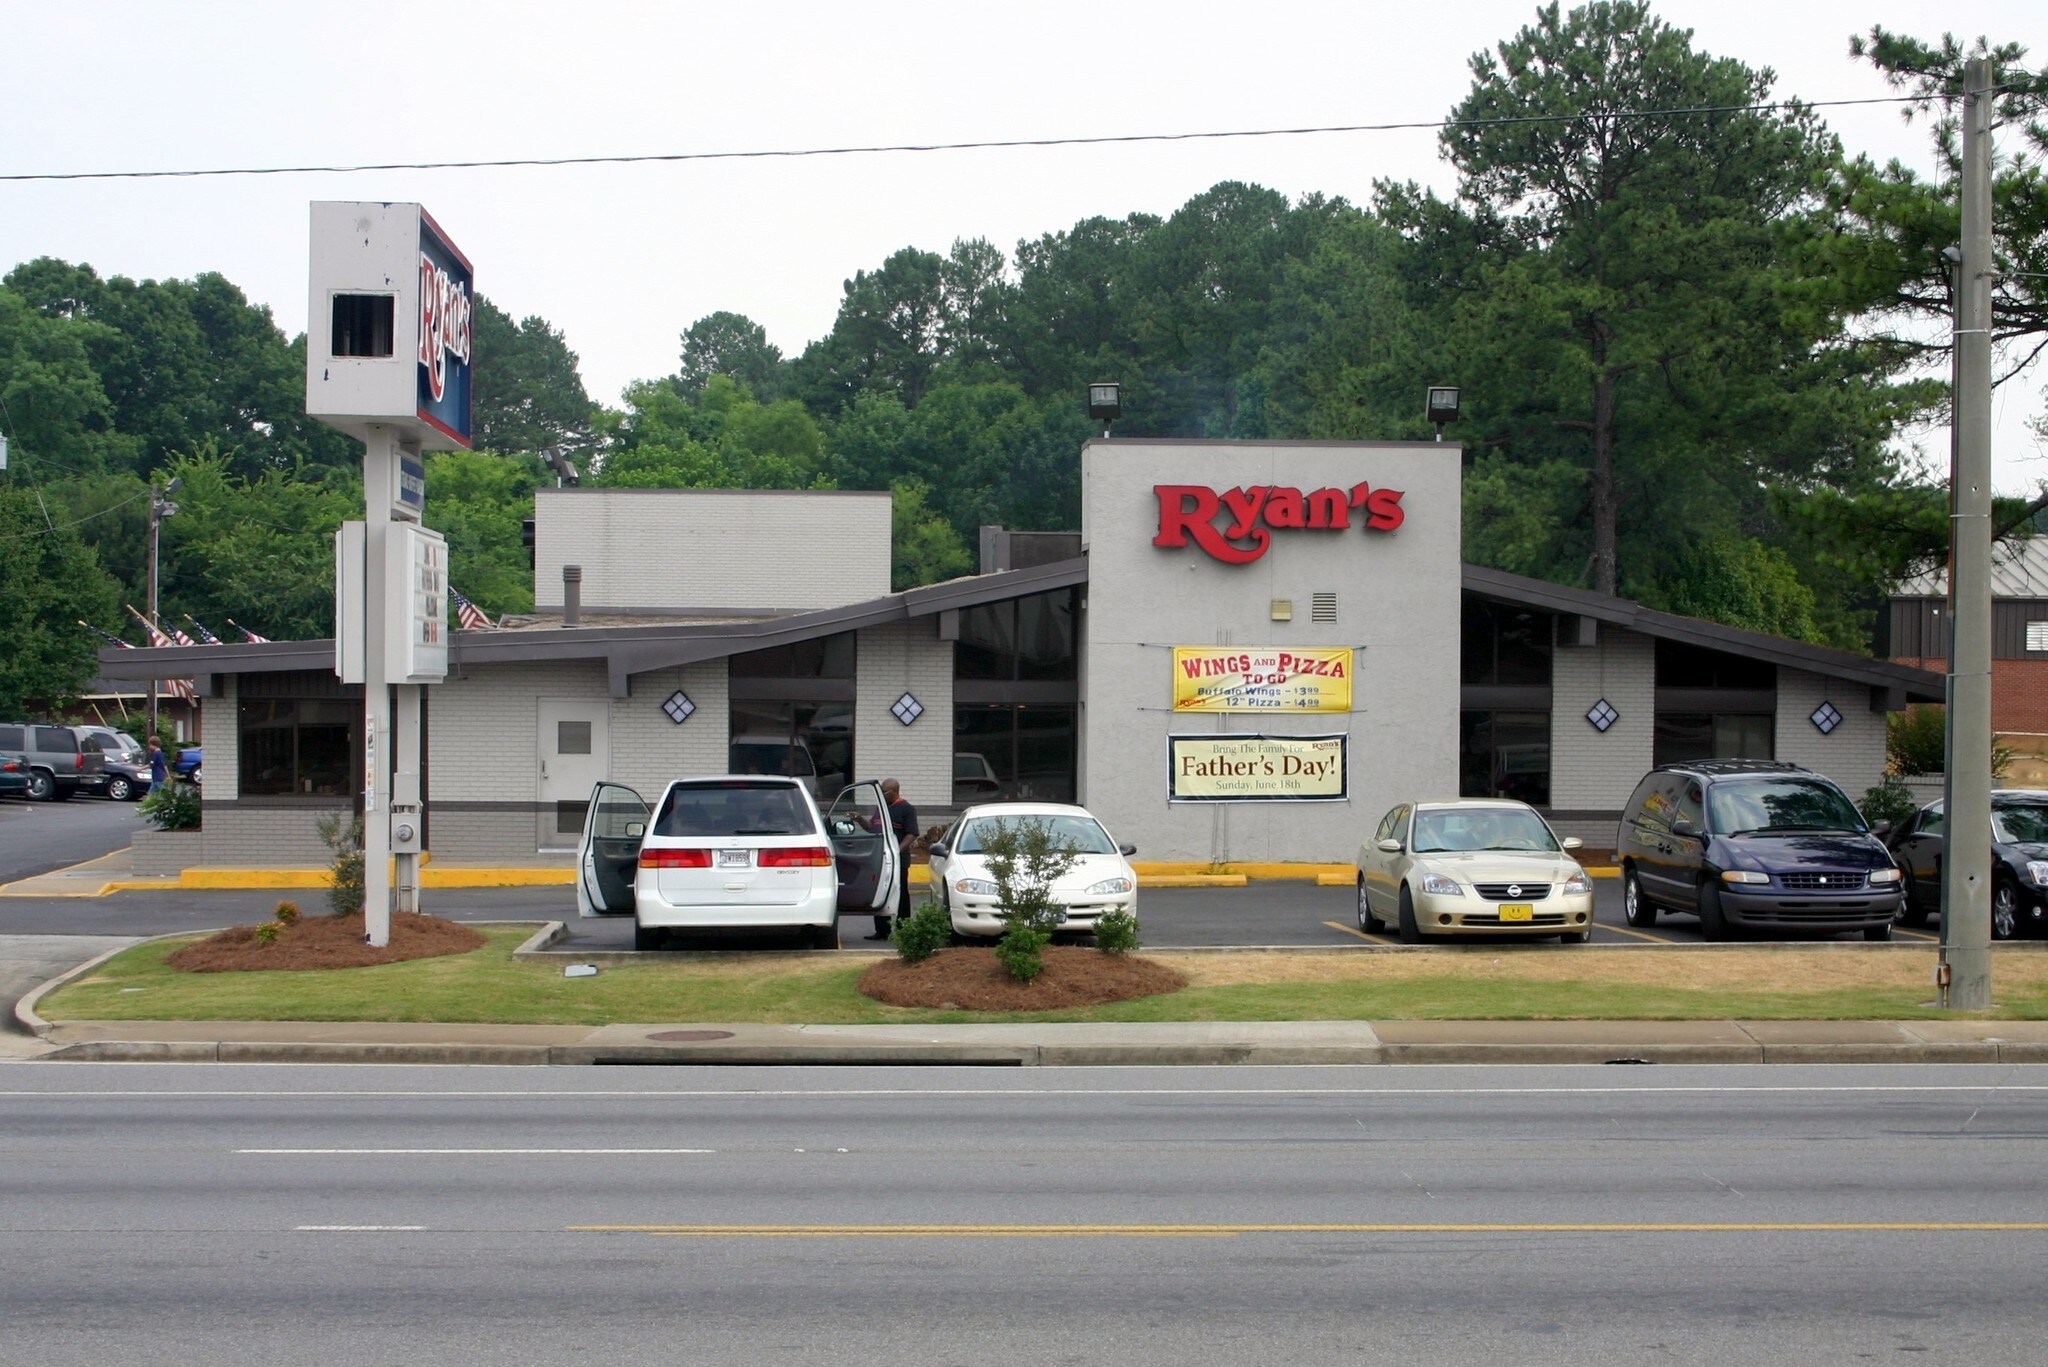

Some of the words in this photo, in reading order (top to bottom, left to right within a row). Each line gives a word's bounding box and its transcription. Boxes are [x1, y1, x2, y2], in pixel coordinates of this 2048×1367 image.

[418, 251, 471, 403] Ryan's
[1152, 480, 1406, 564] Ryan's
[1181, 655, 1251, 679] WINGS
[1254, 658, 1276, 666] AND
[1277, 653, 1344, 678] PIZZA
[1242, 674, 1263, 684] TO
[1267, 674, 1287, 684] GO
[1197, 687, 1242, 696] Buffalo
[1245, 687, 1281, 697] Wings
[1248, 697, 1281, 707] Pizza
[1213, 744, 1237, 756] Bring
[1240, 743, 1256, 753] The
[1258, 744, 1288, 756] Family
[1181, 755, 1274, 776] Father's
[1282, 755, 1335, 782] Day!
[1216, 780, 1253, 791] Sunday,
[1255, 780, 1277, 790] June
[1280, 780, 1301, 789] 18th
